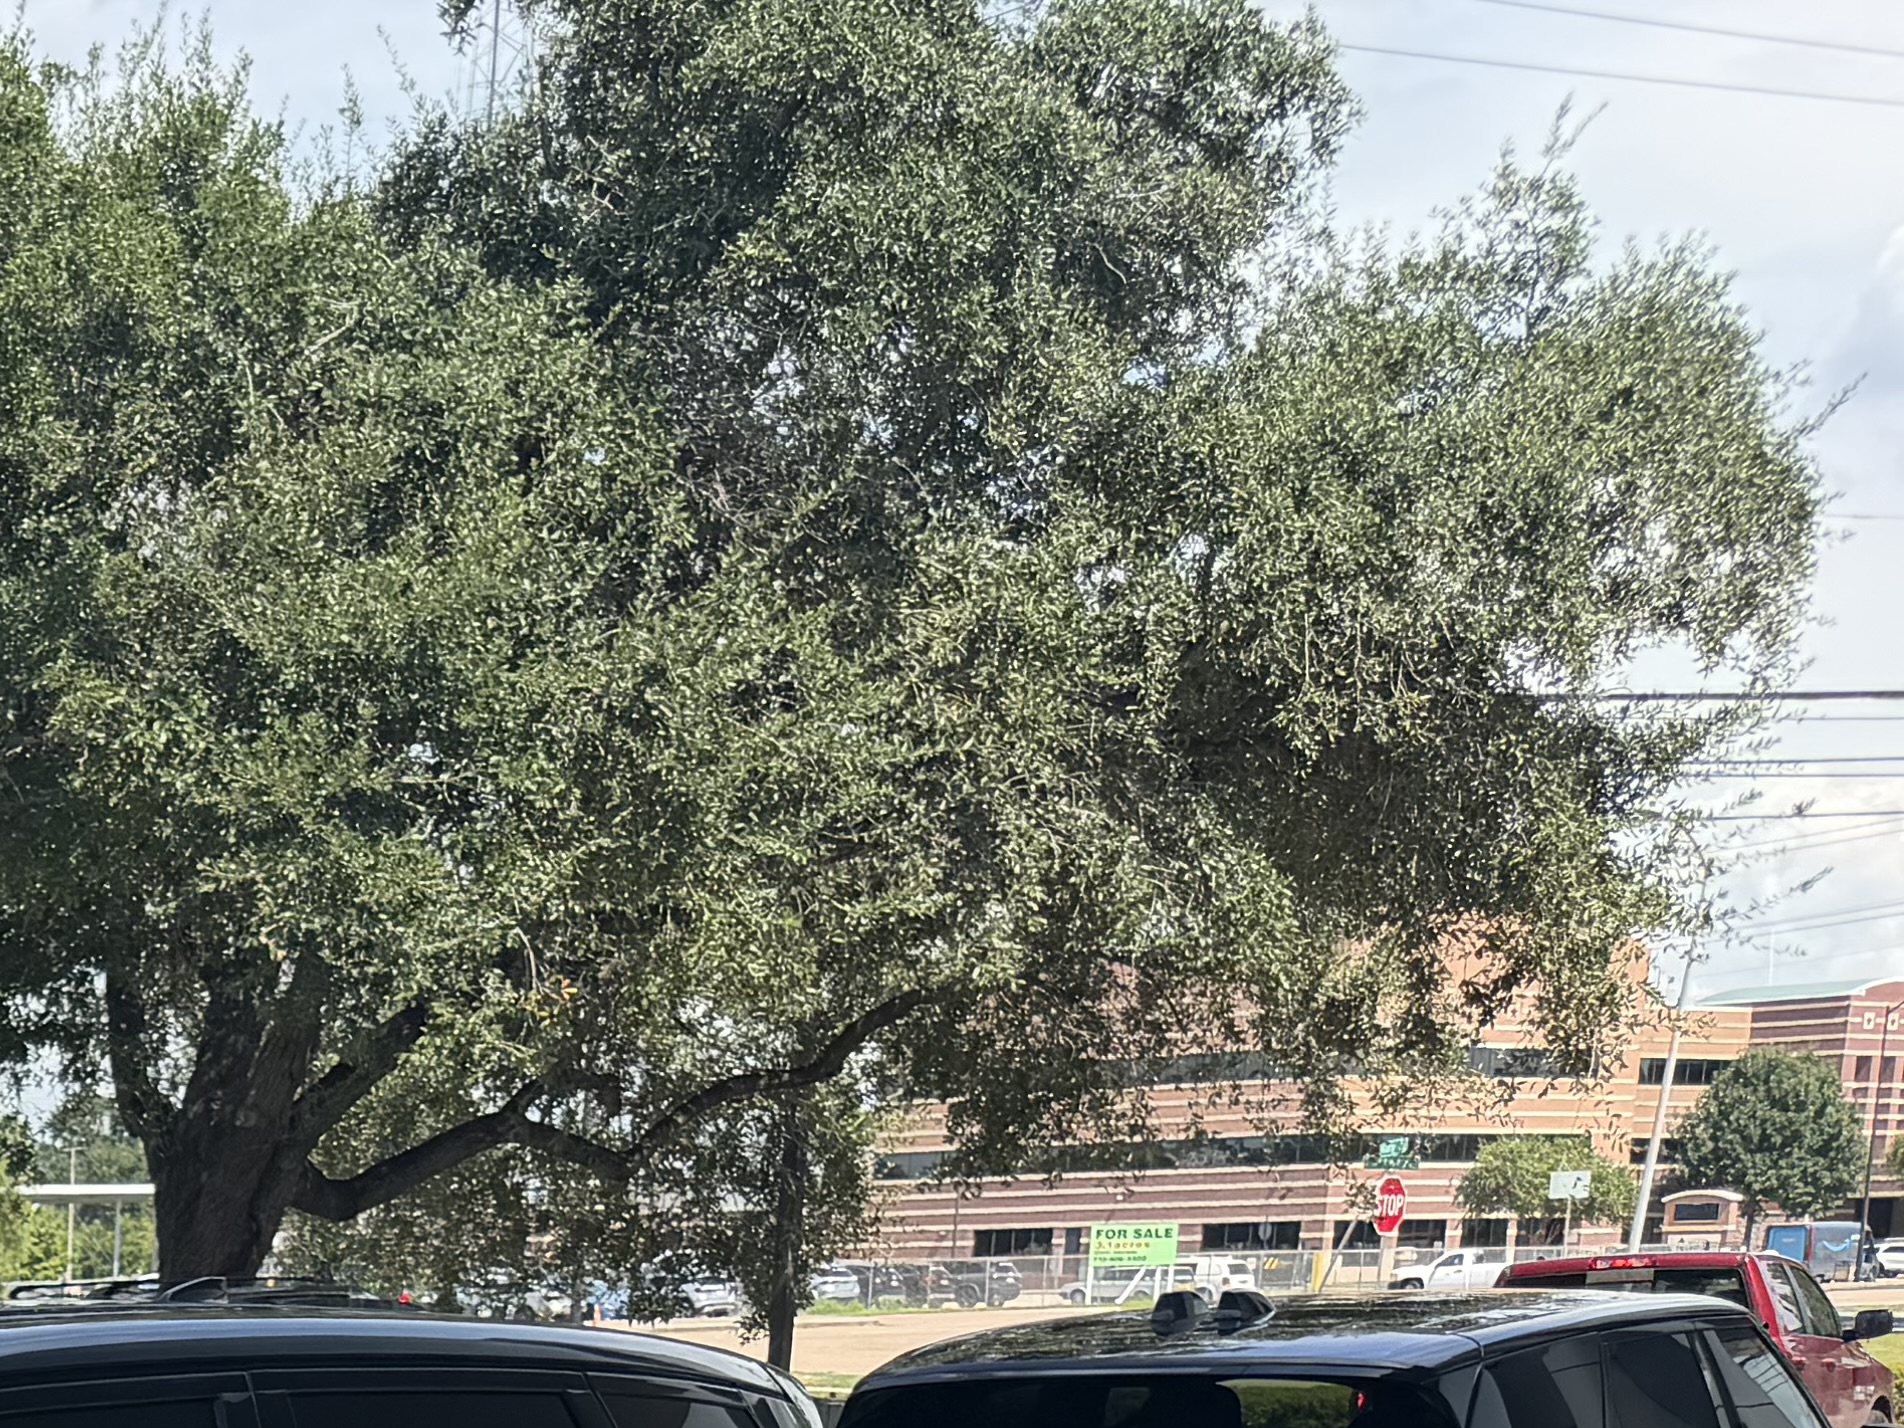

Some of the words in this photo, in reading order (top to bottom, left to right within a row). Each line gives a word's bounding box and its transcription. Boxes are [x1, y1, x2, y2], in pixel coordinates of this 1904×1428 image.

[1373, 1193, 1404, 1217] STOP
[1096, 1228, 1128, 1240] FOR
[1133, 1227, 1174, 1239] SALE
